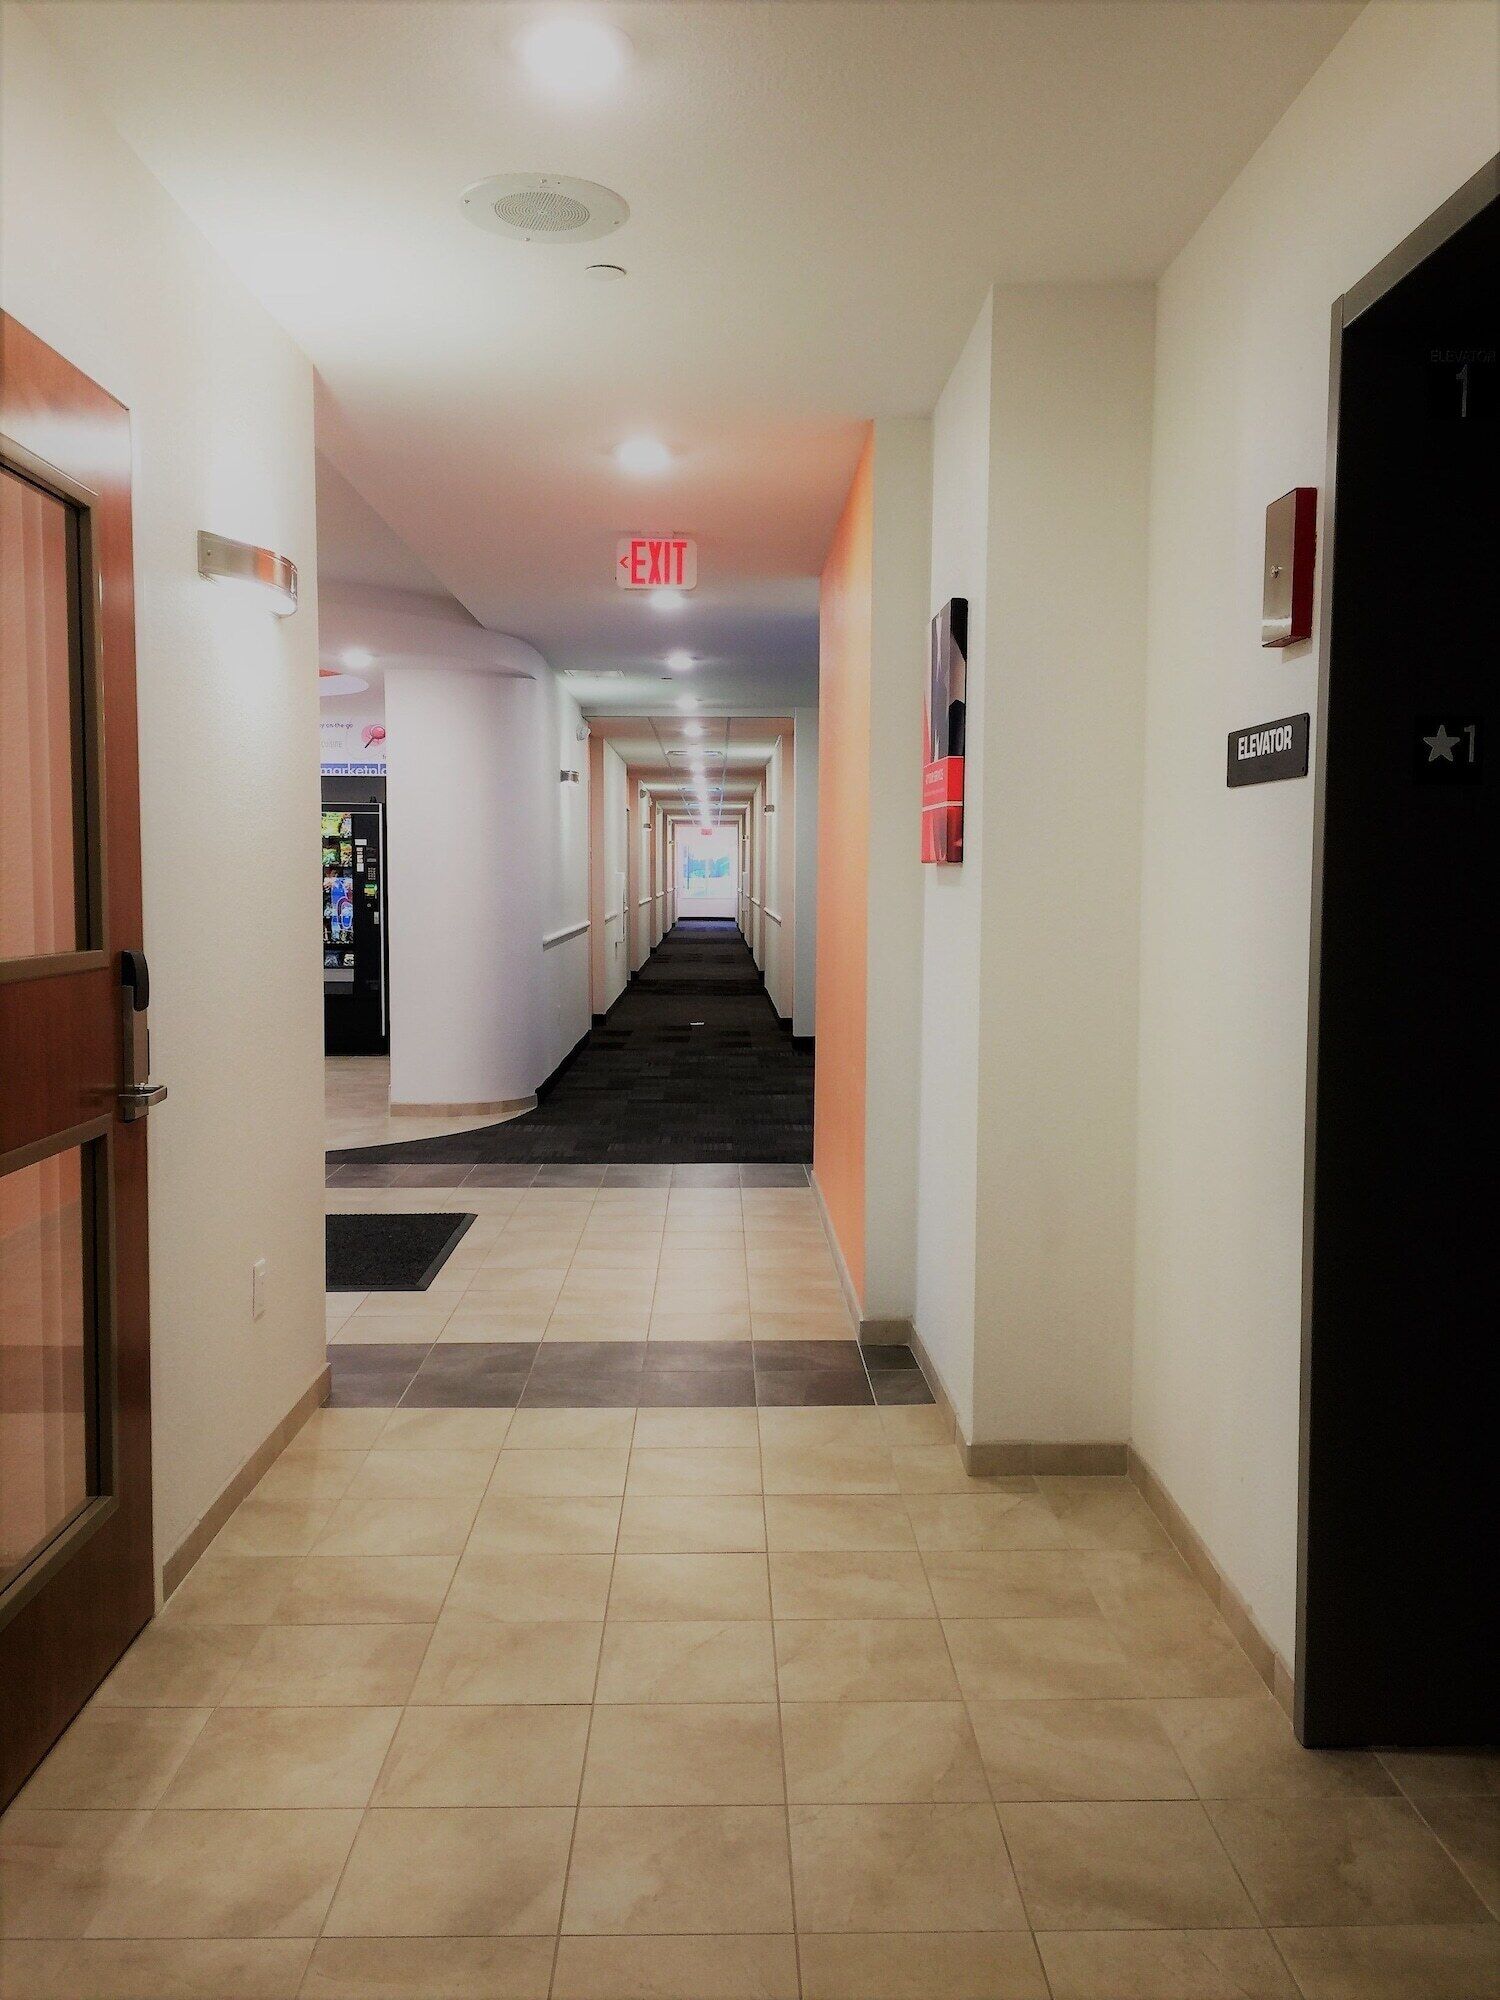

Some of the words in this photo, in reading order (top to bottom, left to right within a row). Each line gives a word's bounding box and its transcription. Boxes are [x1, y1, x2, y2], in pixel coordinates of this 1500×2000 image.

[1456, 363, 1468, 418] 1
[631, 541, 687, 585] EXIT
[1237, 725, 1294, 761] ELEVATOR
[1464, 725, 1475, 763] 1
